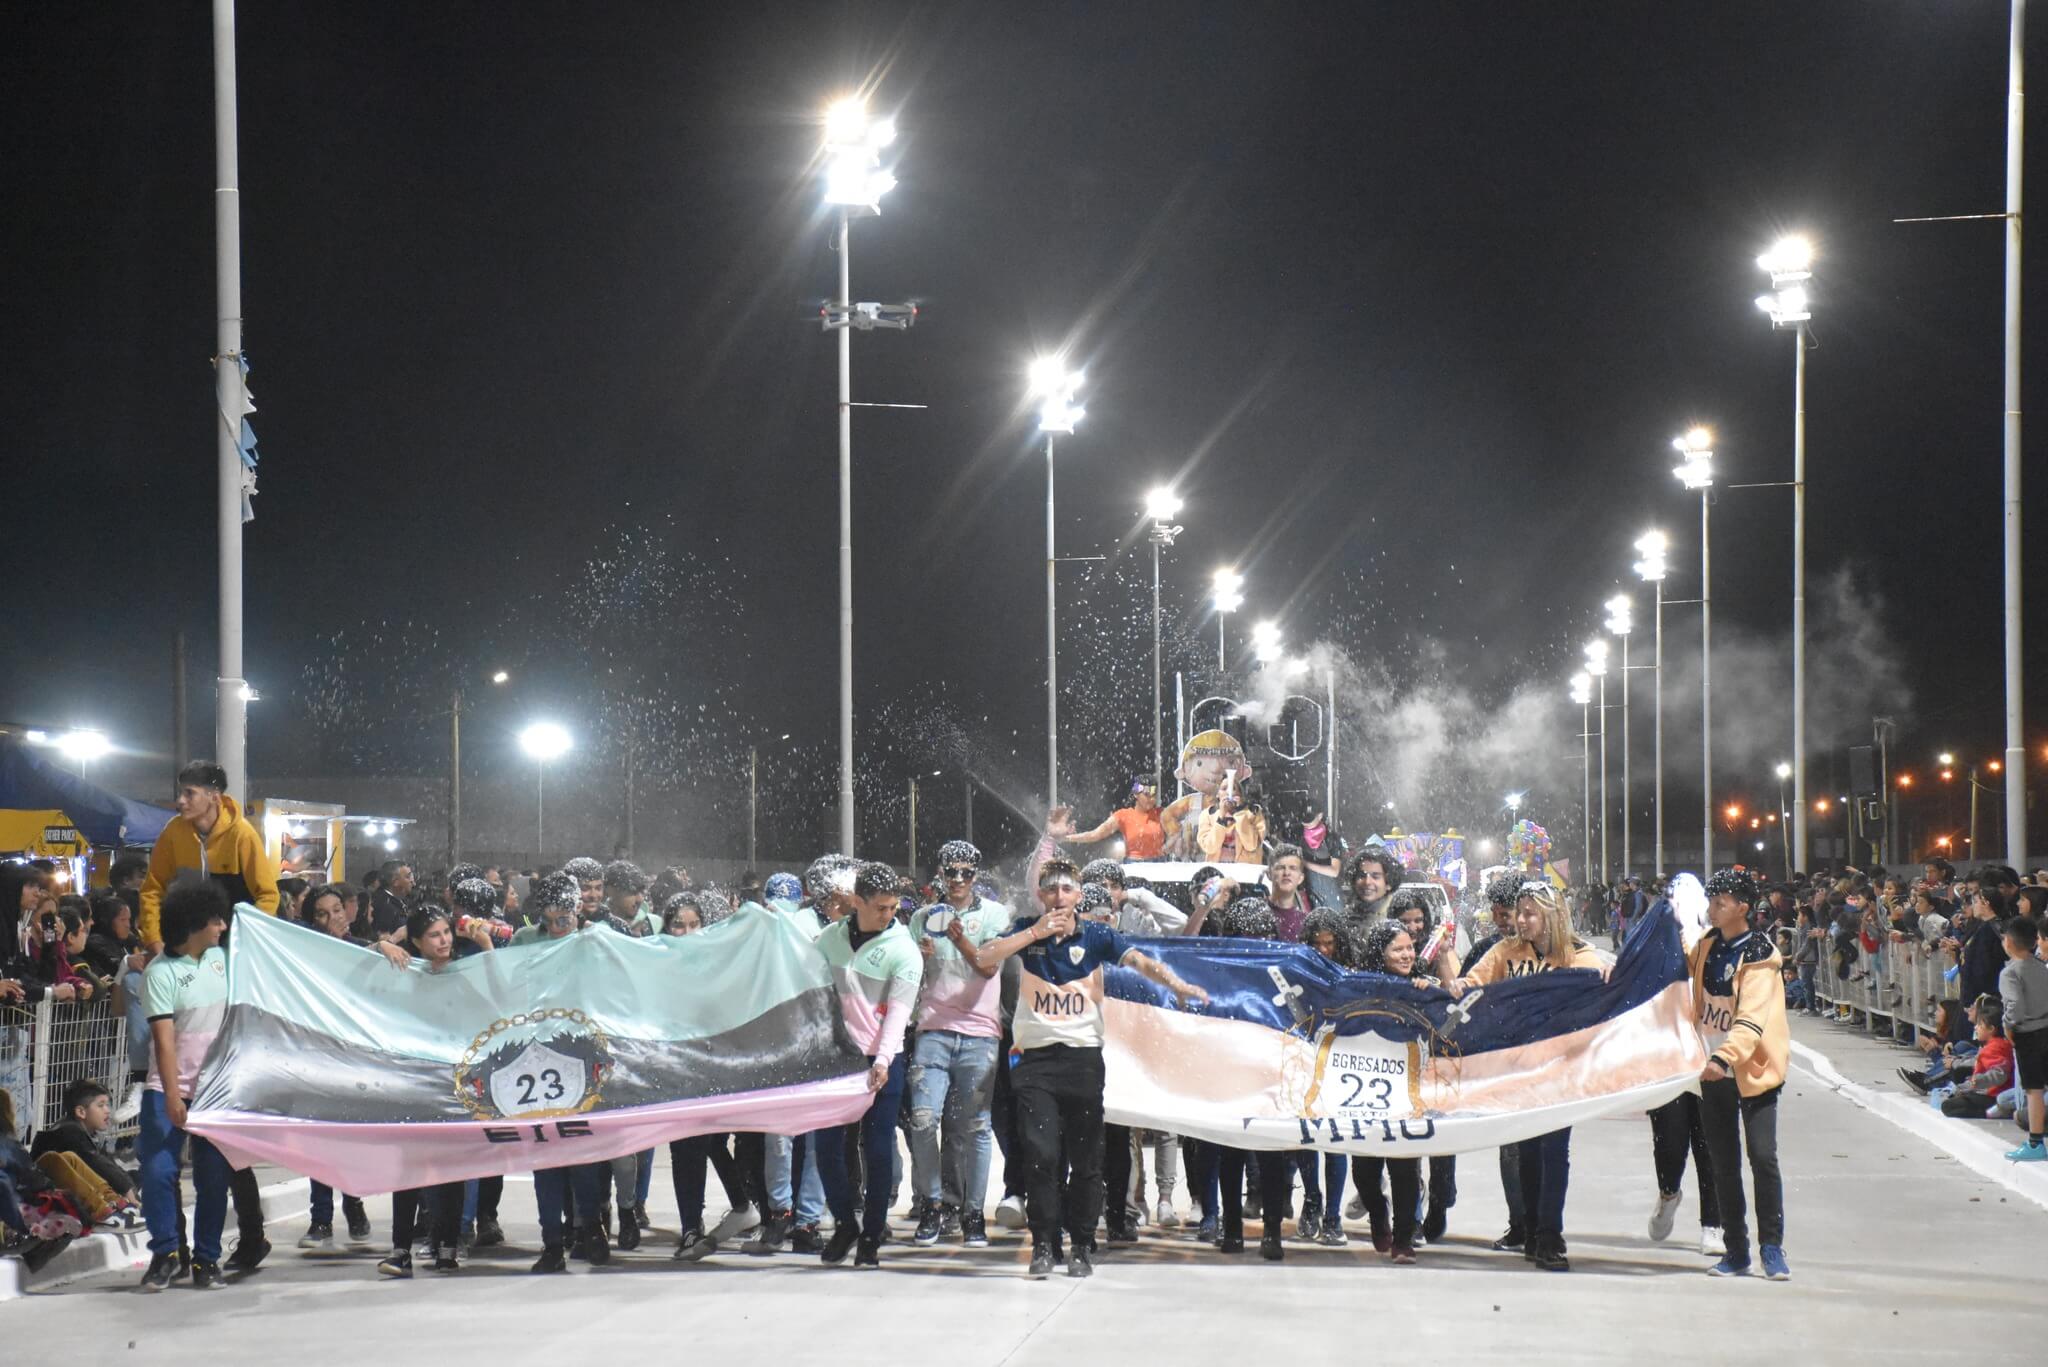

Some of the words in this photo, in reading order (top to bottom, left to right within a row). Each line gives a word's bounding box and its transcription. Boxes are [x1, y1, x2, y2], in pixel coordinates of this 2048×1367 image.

[1034, 991, 1084, 1015] MMO
[1700, 1002, 1732, 1032] MO
[1332, 1053, 1405, 1075] EGRESADOS
[516, 1069, 565, 1105] 23
[1340, 1073, 1392, 1110] 23
[1338, 1110, 1389, 1118] SEXTO
